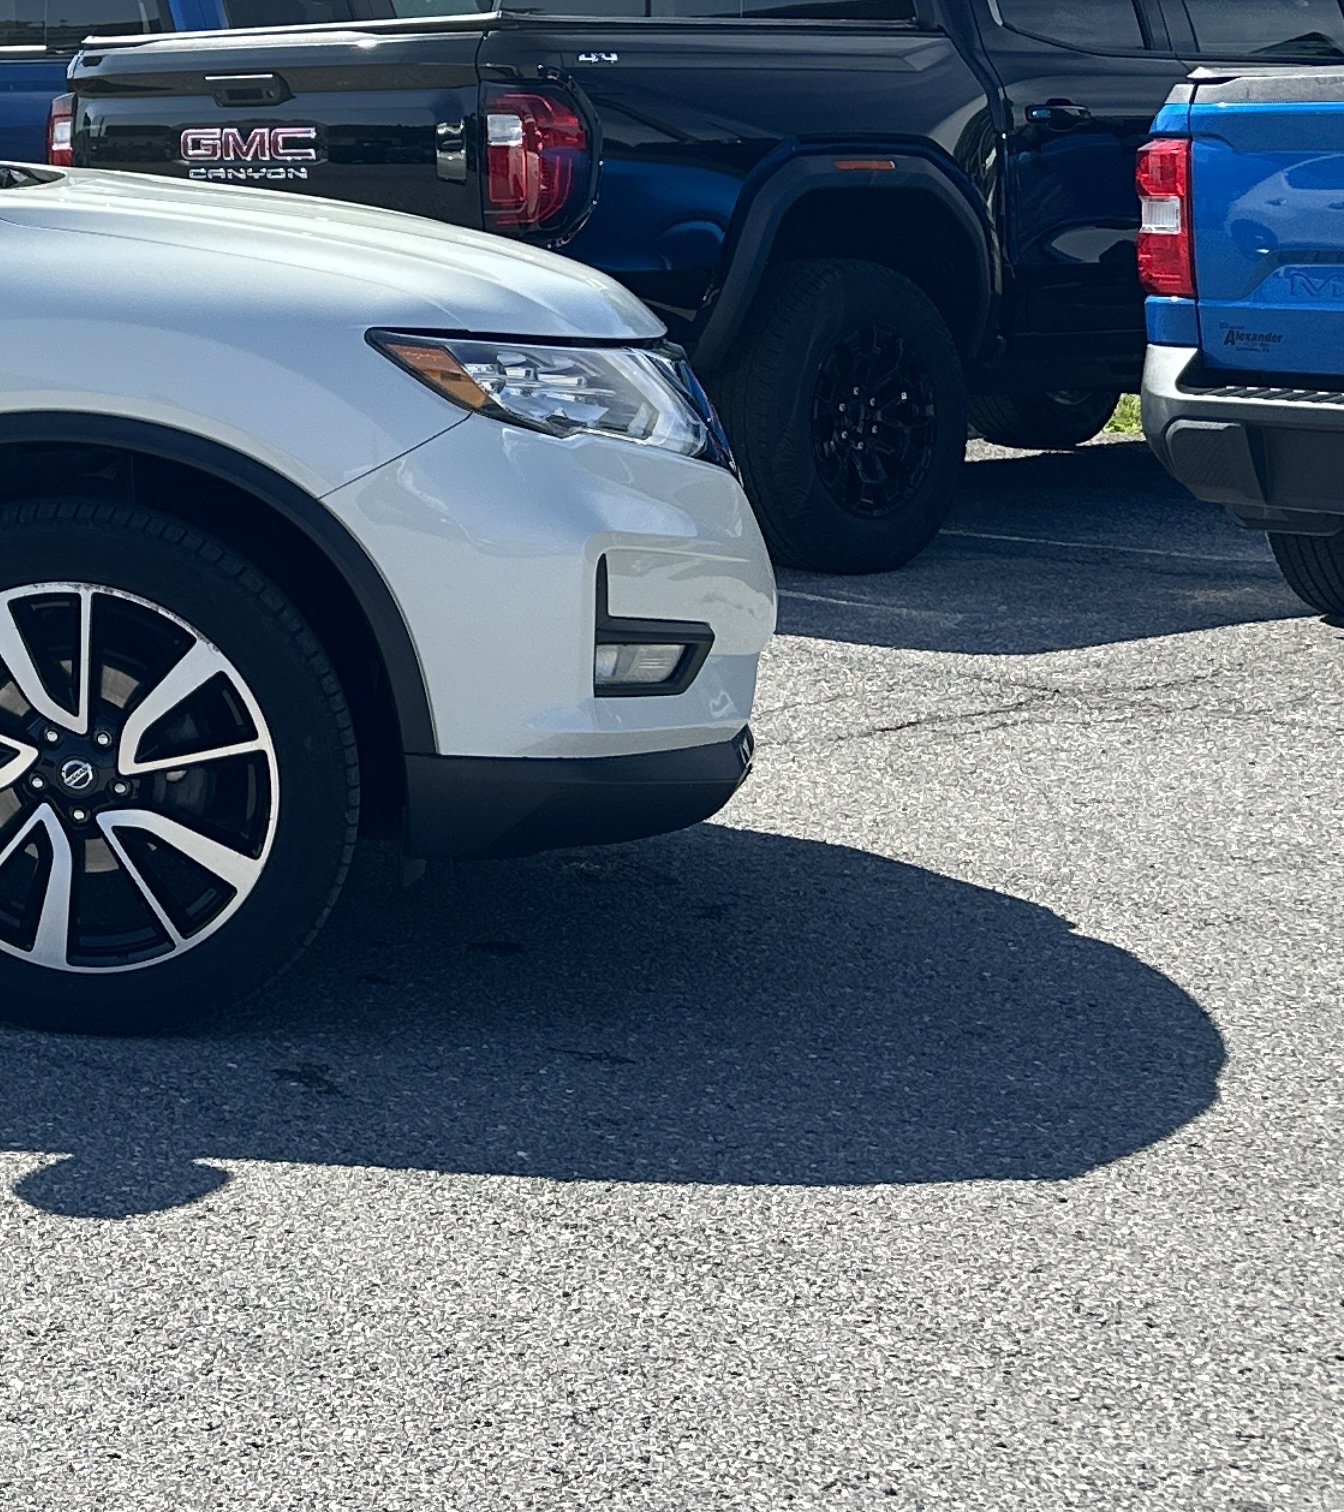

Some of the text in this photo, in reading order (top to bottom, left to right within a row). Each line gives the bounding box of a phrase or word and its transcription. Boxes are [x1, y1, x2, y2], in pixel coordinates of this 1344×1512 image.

[180, 127, 317, 161] GMC
[188, 167, 308, 180] CANYON
[1223, 329, 1284, 345] Alexander
